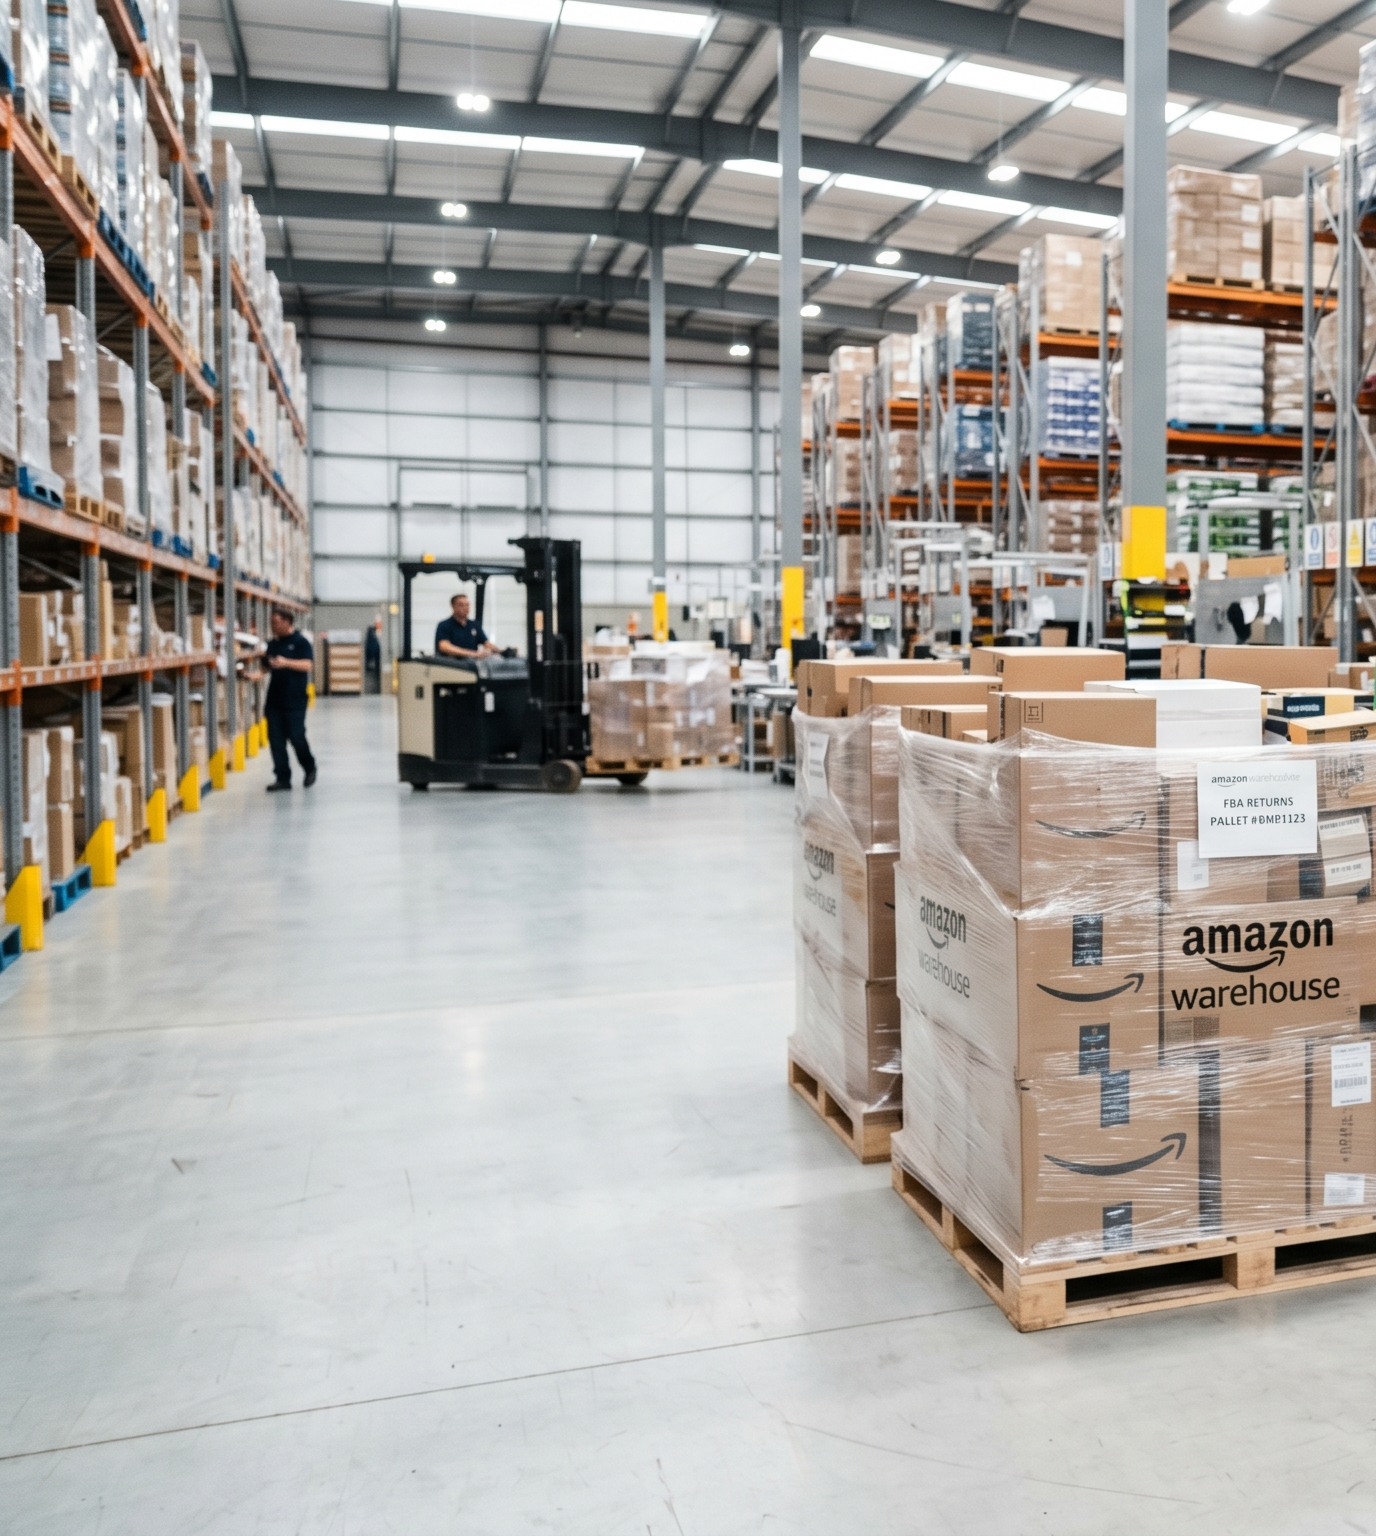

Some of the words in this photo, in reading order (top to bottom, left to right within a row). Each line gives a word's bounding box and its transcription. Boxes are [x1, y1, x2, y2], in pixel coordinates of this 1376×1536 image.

[1211, 775, 1248, 784] amazon
[1223, 798, 1244, 808] FBA
[1247, 796, 1294, 808] RETURNS
[1210, 815, 1248, 826] PALLET
[920, 895, 967, 944] amazon
[1182, 917, 1334, 956] amazon
[1170, 974, 1341, 1011] warehouse
